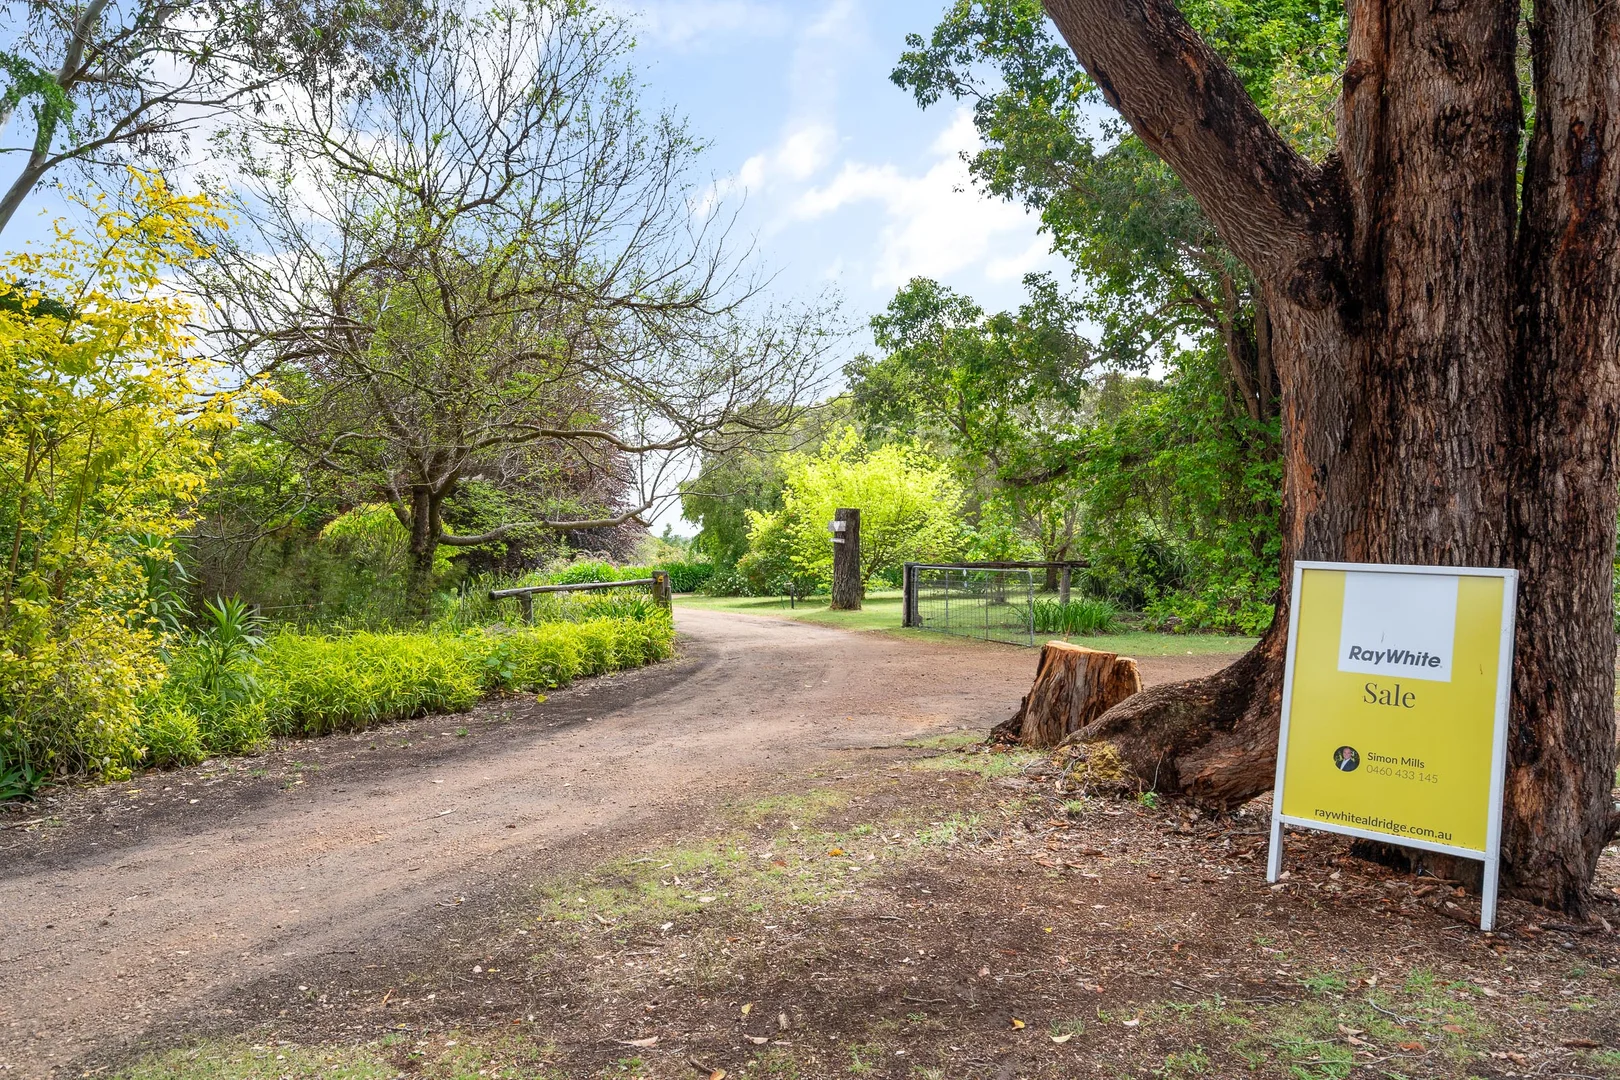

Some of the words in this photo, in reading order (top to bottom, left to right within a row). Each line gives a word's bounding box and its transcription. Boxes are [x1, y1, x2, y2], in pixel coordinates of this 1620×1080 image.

[1348, 645, 1441, 668] RayWhite
[1363, 682, 1416, 709] Sale
[1367, 751, 1398, 765] Simon
[1400, 756, 1425, 769] Mills
[1366, 764, 1393, 777] 0460
[1394, 768, 1415, 780] 433
[1418, 772, 1439, 784] 145
[1314, 808, 1453, 841] raywhitealdridge.com.au
